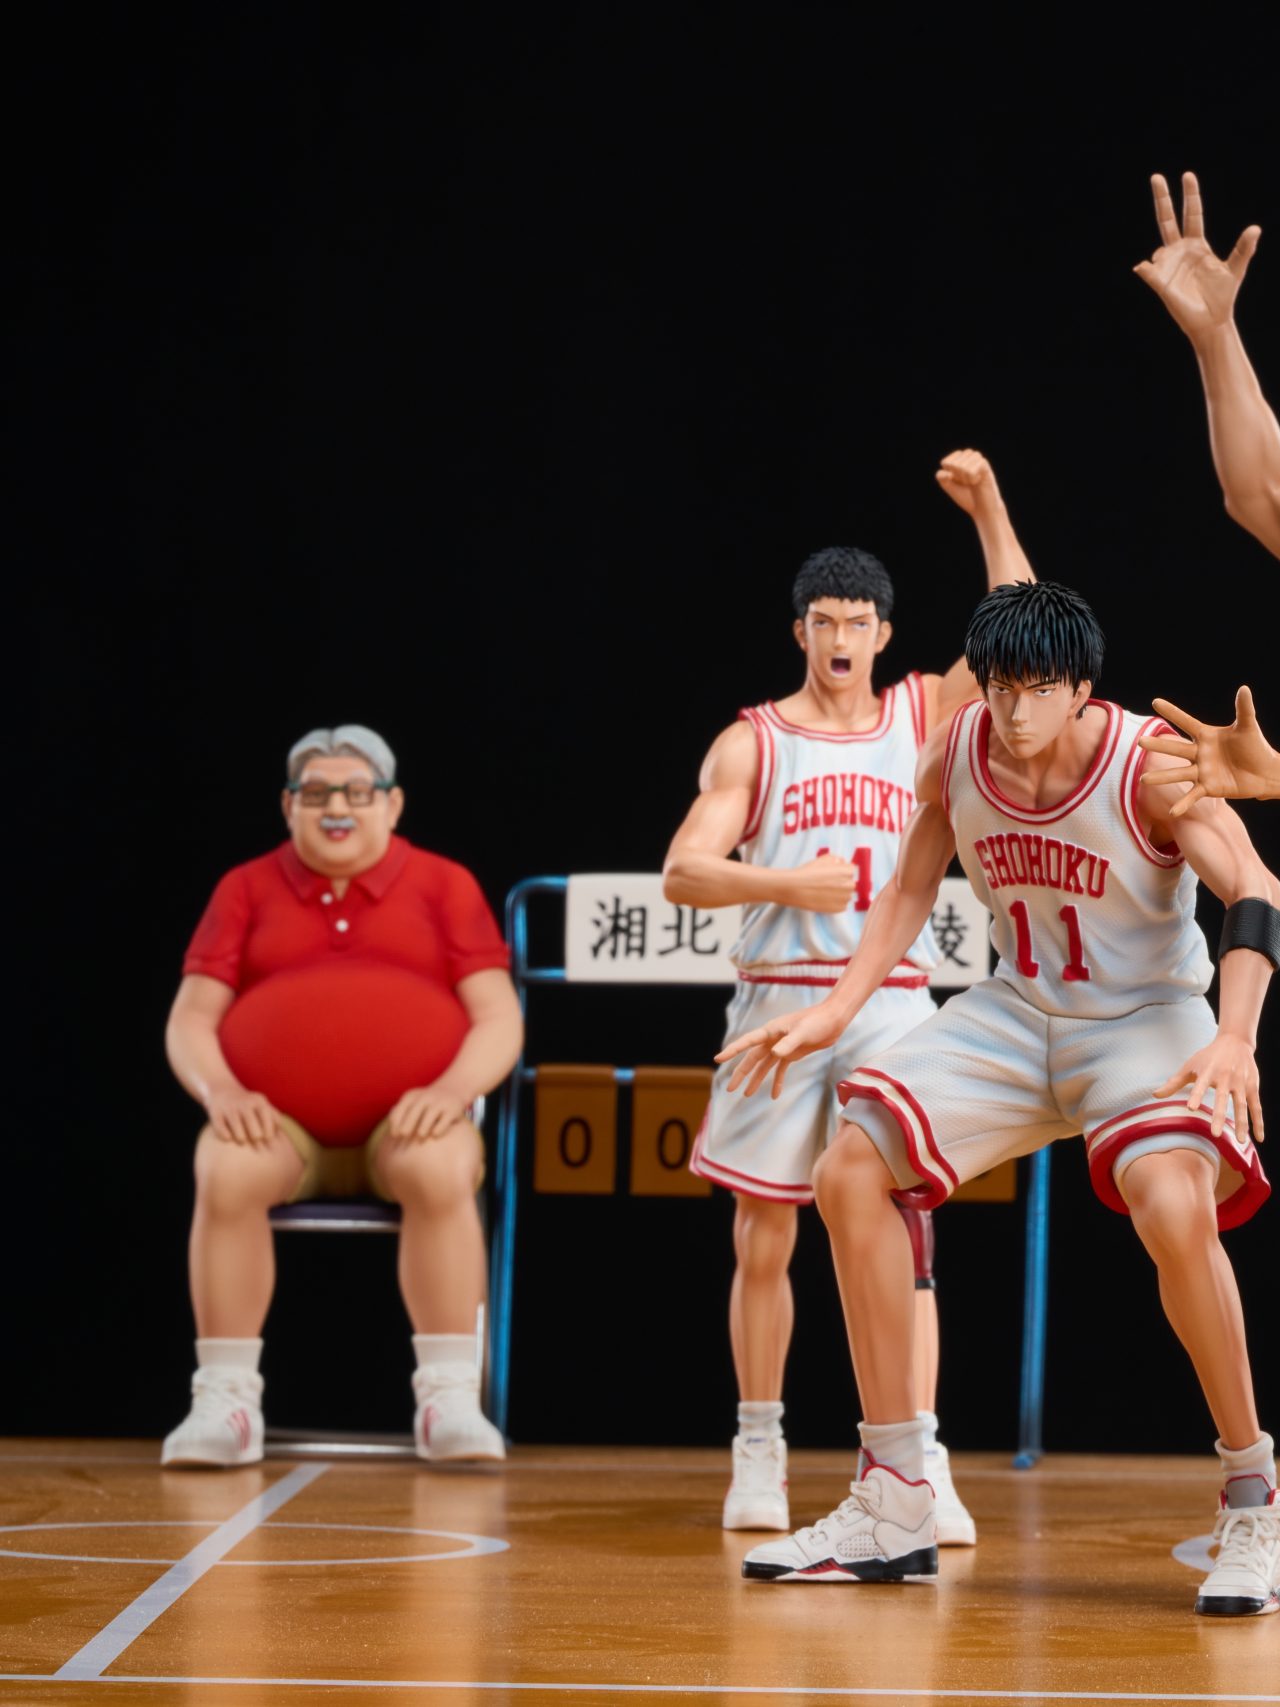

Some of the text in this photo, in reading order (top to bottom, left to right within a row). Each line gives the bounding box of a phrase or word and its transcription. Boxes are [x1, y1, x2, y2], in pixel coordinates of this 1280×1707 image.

[782, 772, 913, 835] SHOHOKU
[974, 832, 1111, 899] SHOHOKU
[590, 895, 720, 959] 湘北
[1009, 899, 1091, 982] 11
[559, 1117, 690, 1169] 0 0
